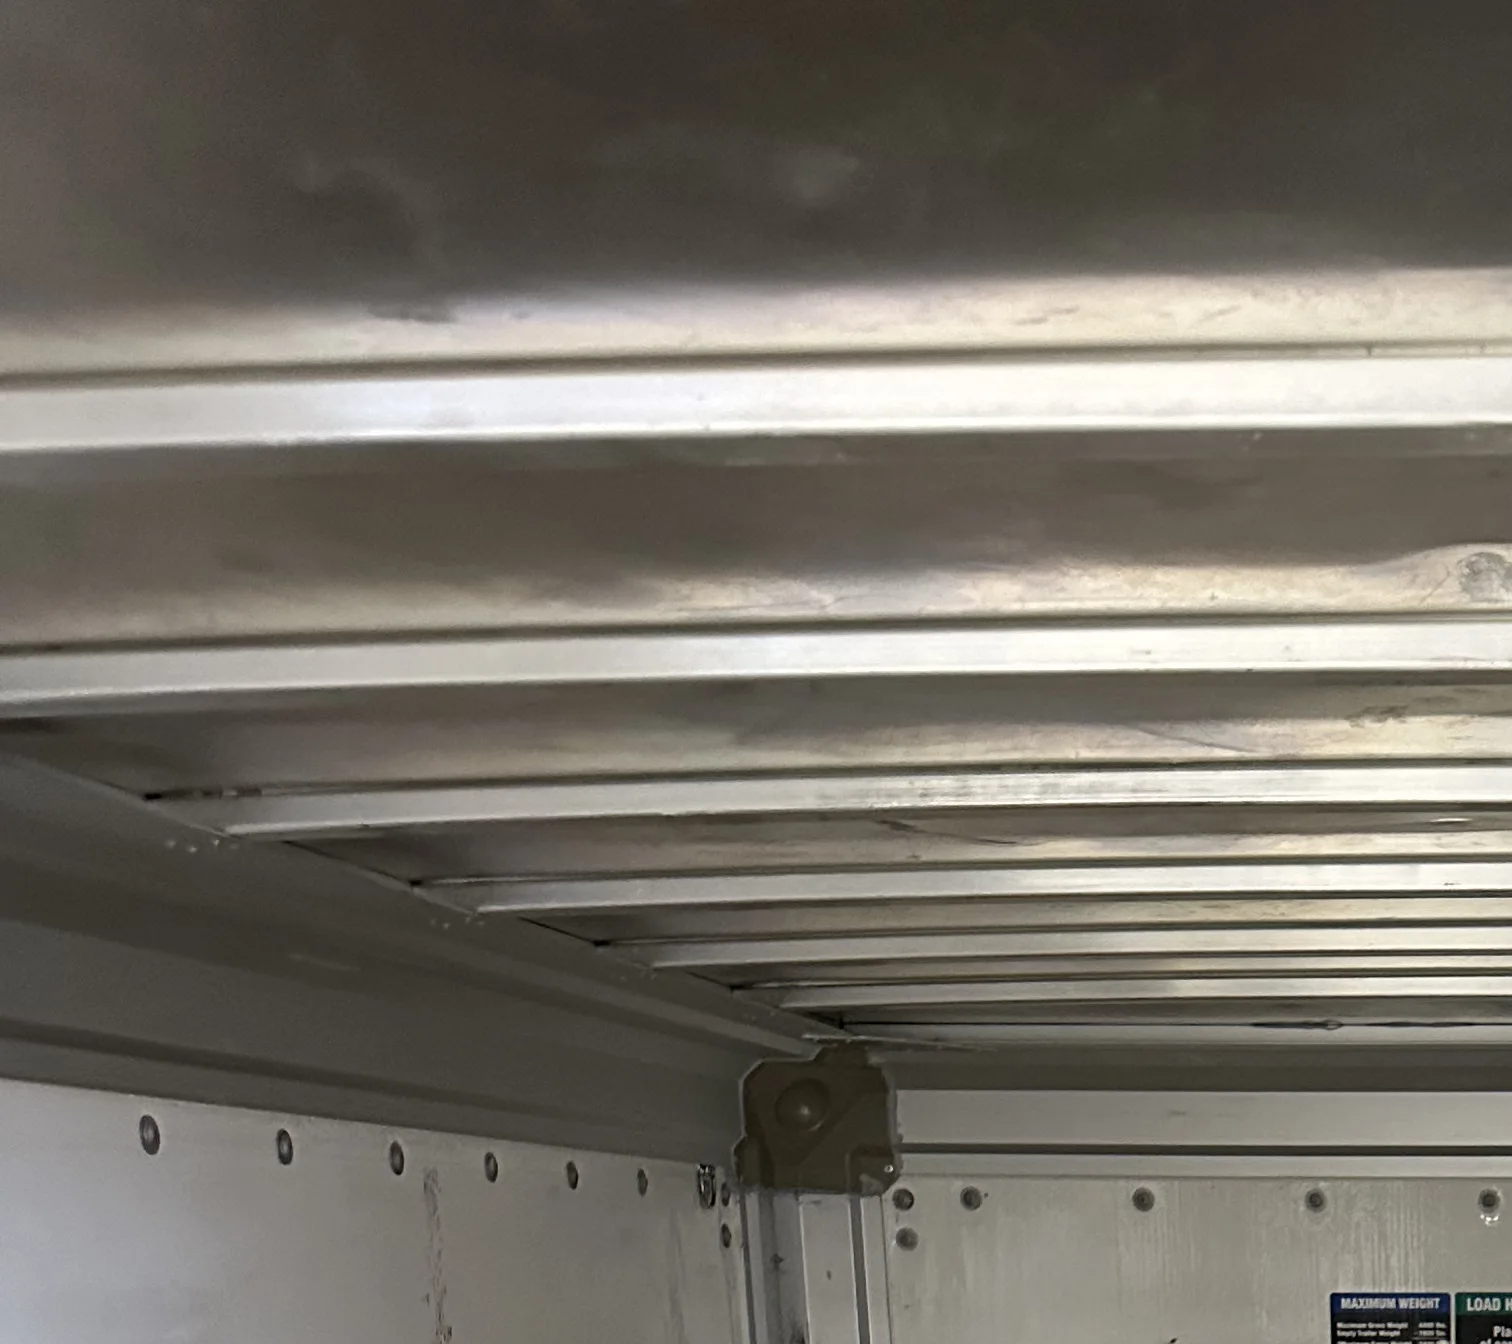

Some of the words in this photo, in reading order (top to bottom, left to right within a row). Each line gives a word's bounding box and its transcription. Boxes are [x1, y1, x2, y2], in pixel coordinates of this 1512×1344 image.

[1341, 1297, 1396, 1309] MAXIMUM
[1399, 1297, 1440, 1309] WEIGHT
[1466, 1297, 1500, 1311] LOAD
